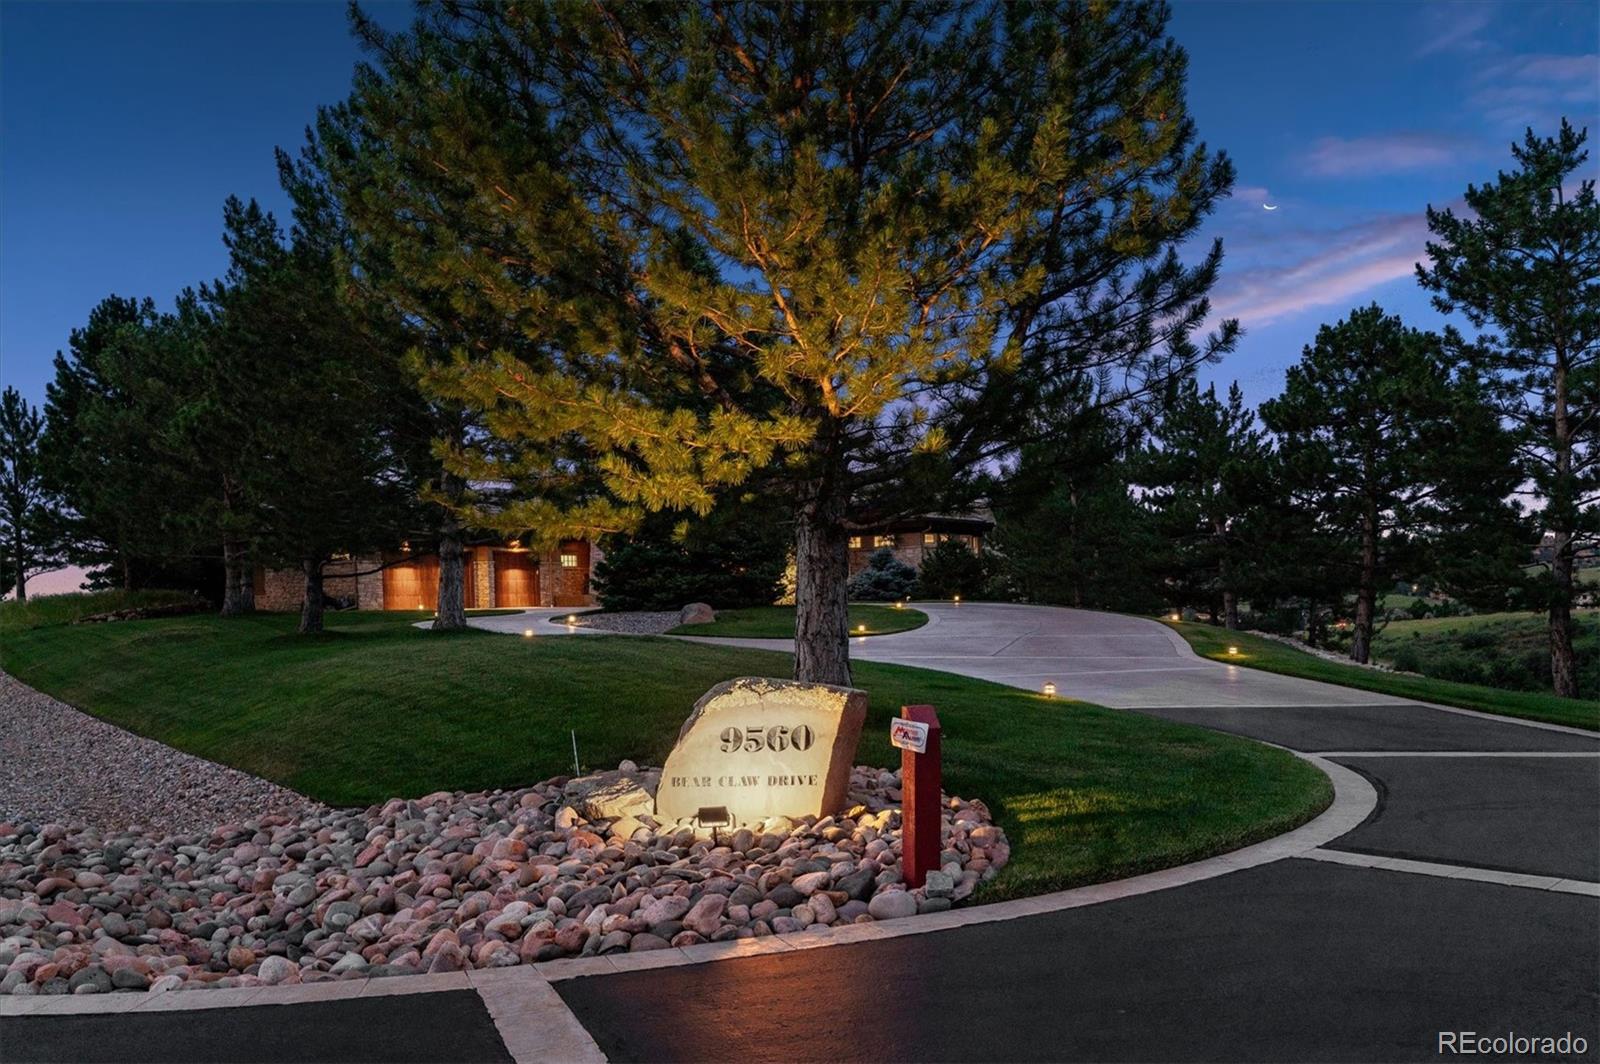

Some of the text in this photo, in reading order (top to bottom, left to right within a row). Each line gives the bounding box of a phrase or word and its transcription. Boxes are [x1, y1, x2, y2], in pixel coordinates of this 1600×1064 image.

[720, 724, 815, 753] 9560
[671, 774, 818, 788] BEAR CLAW DRIVE
